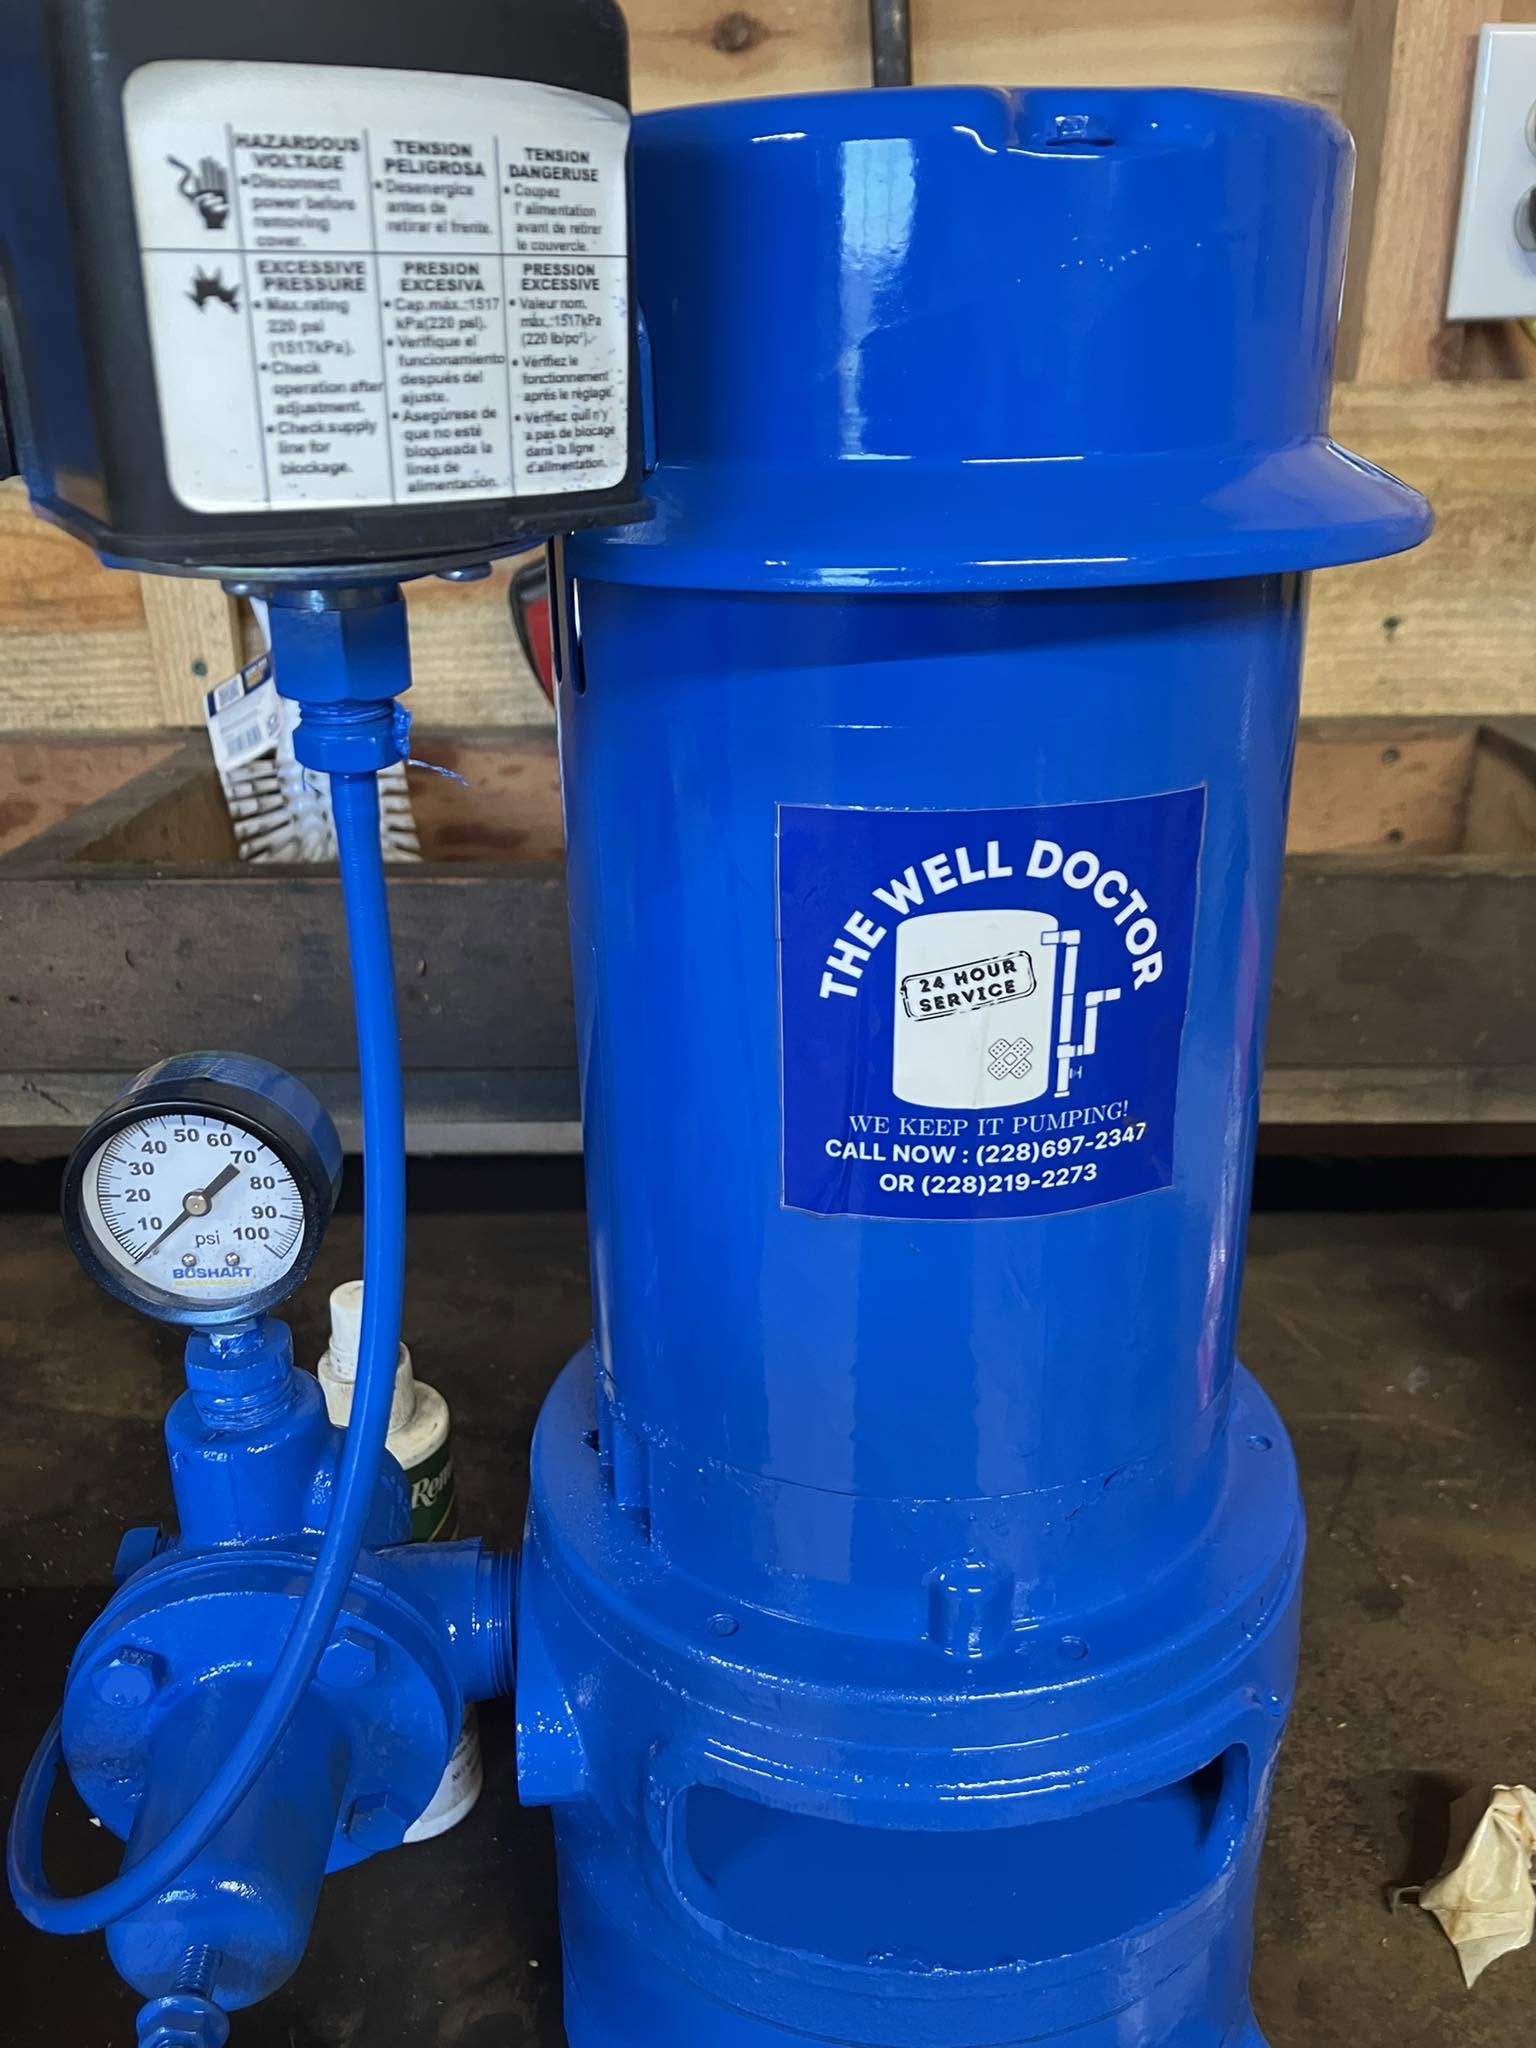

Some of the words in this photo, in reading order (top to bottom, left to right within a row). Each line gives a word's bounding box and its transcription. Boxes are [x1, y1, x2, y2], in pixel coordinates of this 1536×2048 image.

[235, 133, 360, 152] HAZARDOUS
[393, 139, 472, 157] TENSION
[252, 153, 344, 170] VOLTAGE
[524, 147, 590, 163] TENSION
[384, 158, 486, 177] PELIGROSA
[509, 165, 599, 182] DANGERUSE
[514, 183, 560, 200] Coupez
[430, 201, 446, 213] de
[552, 222, 566, 233] de
[257, 260, 366, 275] EXCESSIVE
[404, 262, 479, 275] PRESION
[523, 263, 595, 276] PRESSION
[263, 277, 367, 291] PRESSURE
[400, 278, 484, 292] EXCESIVA
[521, 279, 600, 291] EXCESSIVE
[520, 297, 557, 310] Valeur
[272, 361, 322, 375] Check
[481, 406, 497, 419] de
[433, 429, 450, 438] no
[819, 911, 887, 999] THE
[872, 840, 1013, 915] WELL
[1026, 839, 1162, 990] DOCTOR
[918, 977, 945, 993] 24
[954, 958, 1018, 987] HOUR
[918, 979, 1017, 1013] SERVICE
[849, 1115, 889, 1135] WE
[899, 1117, 969, 1137] KEEP
[977, 1117, 1004, 1137] IT
[1012, 1100, 1129, 1135] PUMPING!
[173, 1128, 200, 1143] 50
[206, 1132, 233, 1147] 60
[141, 1140, 167, 1155] 40
[825, 1138, 886, 1162] CALL
[892, 1144, 956, 1164] NOW
[976, 1122, 1148, 1167] (228)697-2347
[230, 1150, 256, 1164] 70
[129, 1161, 155, 1176] 30
[249, 1176, 276, 1190] 80
[879, 1173, 915, 1194] OR
[922, 1163, 1098, 1196] (228)219-2273
[124, 1188, 151, 1202] 20
[251, 1205, 277, 1219] 90
[137, 1216, 163, 1231] 10
[195, 1230, 220, 1246] psi
[232, 1227, 270, 1241] 100
[172, 1266, 253, 1280] BOSHART
